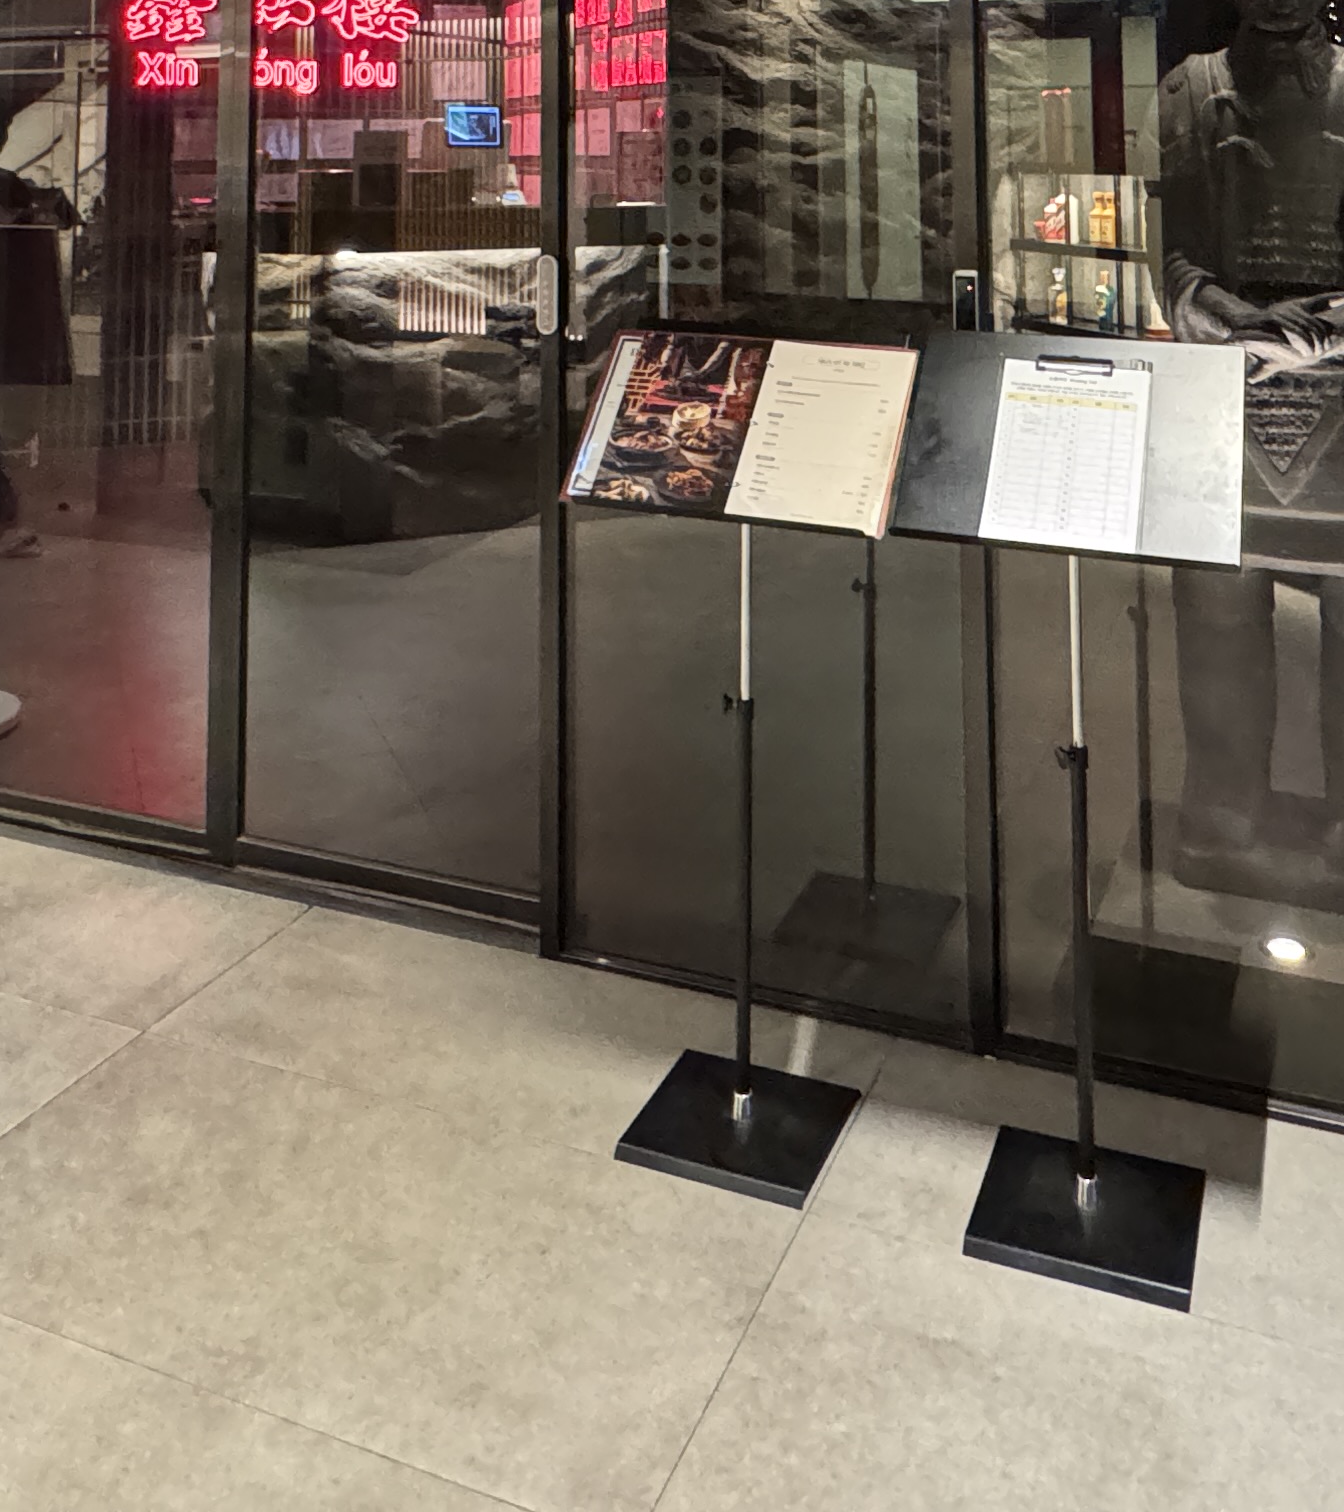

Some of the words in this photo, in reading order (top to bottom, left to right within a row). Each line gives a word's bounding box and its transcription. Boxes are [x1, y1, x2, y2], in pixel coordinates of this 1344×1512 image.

[136, 51, 200, 87] Xin
[255, 47, 321, 96] óng
[342, 48, 399, 88] lóu
